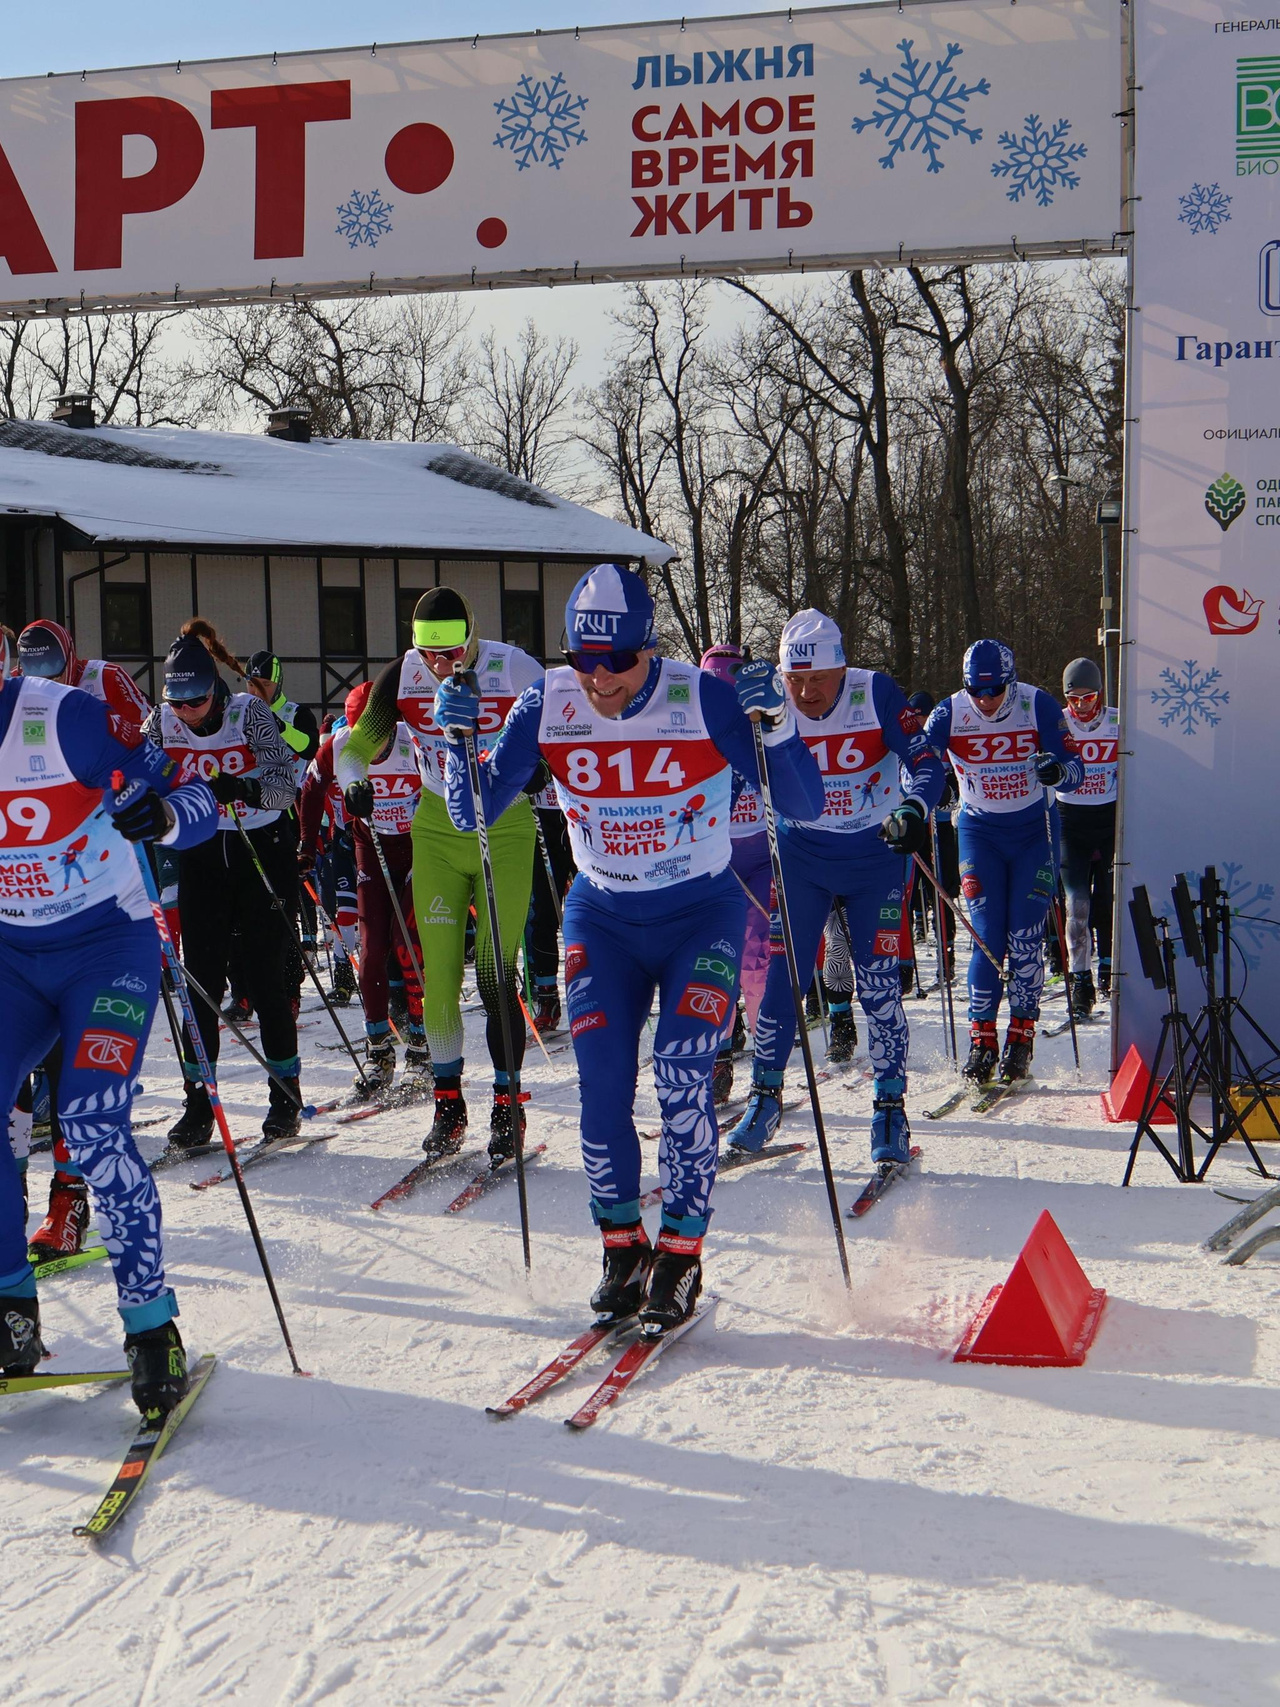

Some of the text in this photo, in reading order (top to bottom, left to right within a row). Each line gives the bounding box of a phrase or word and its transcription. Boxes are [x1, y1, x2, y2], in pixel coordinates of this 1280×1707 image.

[631, 43, 814, 90] ЛЫЖНЯ
[631, 94, 815, 142] САМОЕ
[631, 139, 813, 188] ВРЕМЯ
[629, 187, 813, 237] ЖИТЬ
[1203, 427, 1280, 441] ОФИЦИАЛ
[574, 613, 622, 635] RWT
[786, 643, 817, 658] RWT
[742, 661, 767, 675] COXA
[418, 702, 502, 731] 35
[810, 738, 865, 771] 16
[967, 734, 1036, 762] 325
[1080, 742, 1116, 761] 07
[182, 750, 245, 782] 408
[566, 746, 686, 792] 814
[980, 765, 1026, 774] ЛЫЖНЯ
[981, 772, 1027, 783] САМОЕ
[981, 780, 1028, 791] ВРЕМЯ
[115, 780, 141, 806] COXA
[983, 789, 1029, 800] ЖИТЬ
[598, 804, 663, 817] ЛЫЖНЯ
[821, 807, 853, 817] ИТЬ
[599, 818, 665, 833] САМОЕ
[602, 839, 667, 857] ЖИТЬ
[591, 864, 639, 882] КОМАНДА
[694, 957, 736, 986] BCM
[92, 997, 145, 1025] BCM
[572, 1016, 599, 1035] swix
[606, 1229, 642, 1243] MADSHUS
[659, 1236, 698, 1247] MADSHUS
[38, 1259, 68, 1275] FISCHER
[87, 1490, 127, 1533] FISCHER
